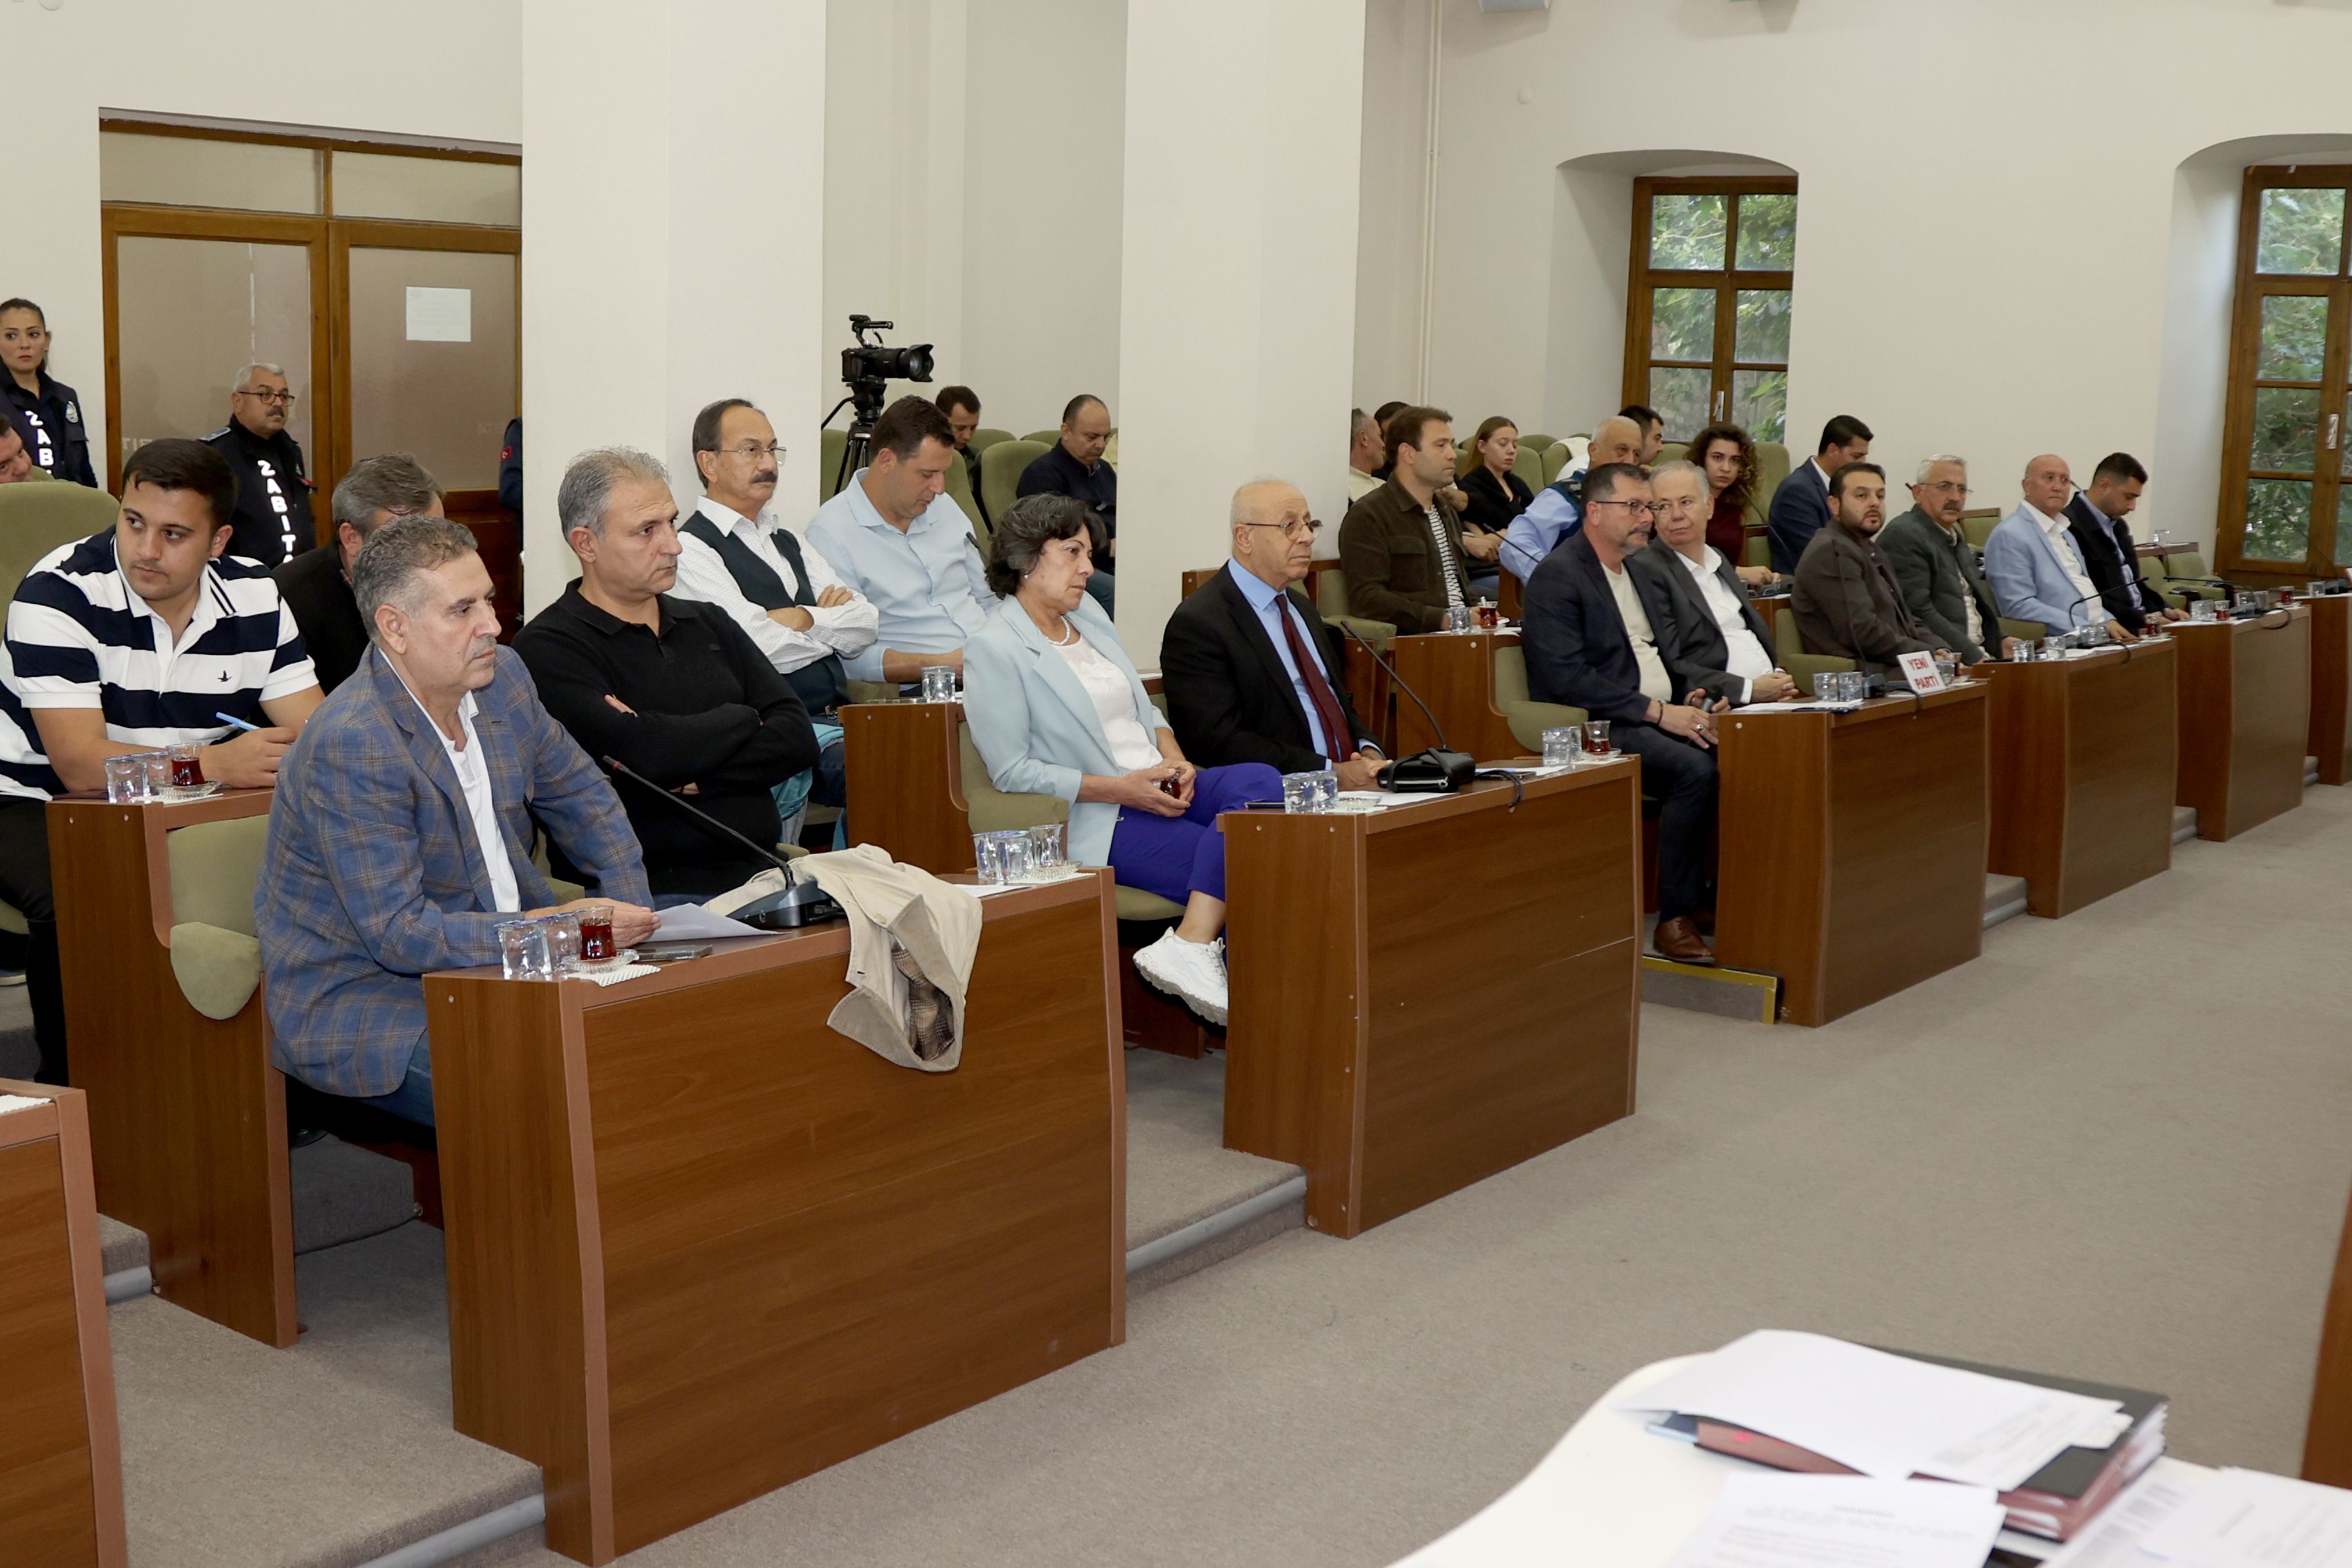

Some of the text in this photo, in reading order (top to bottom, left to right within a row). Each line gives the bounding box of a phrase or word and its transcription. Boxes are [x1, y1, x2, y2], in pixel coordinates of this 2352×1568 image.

[25, 410, 54, 474] ZAB
[1907, 654, 1930, 671] YENİ
[1914, 673, 1940, 689] PARTİ
